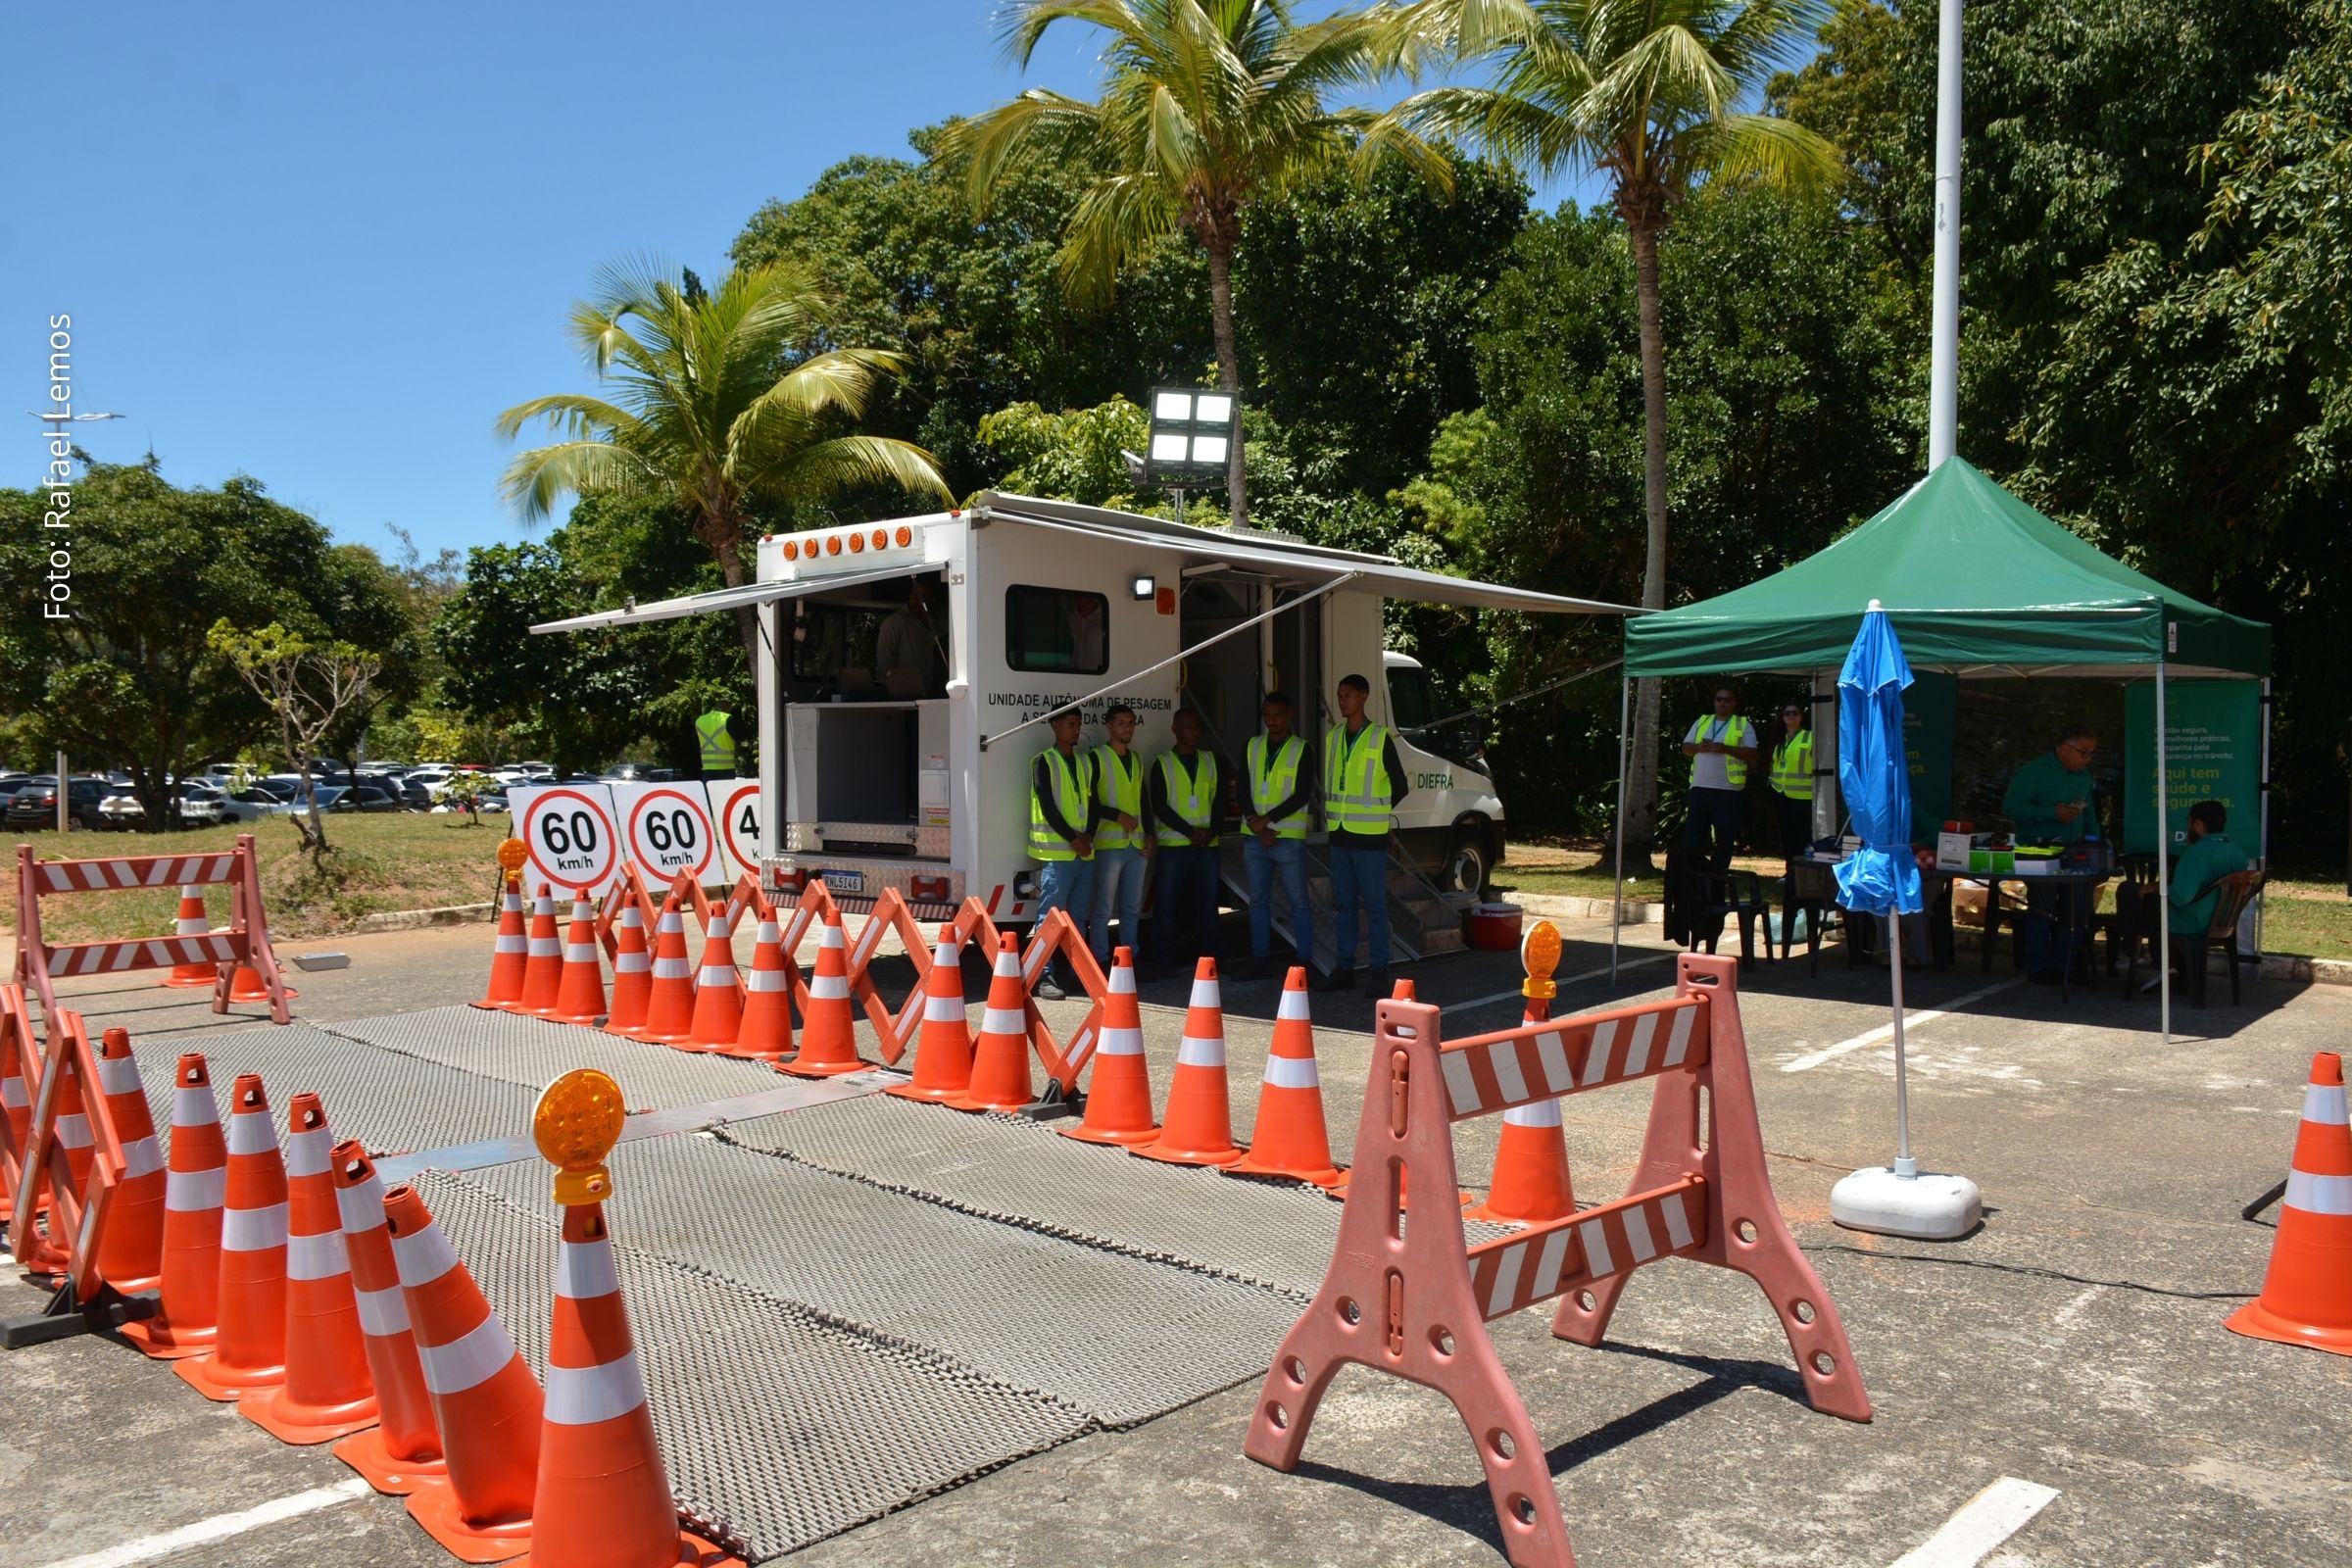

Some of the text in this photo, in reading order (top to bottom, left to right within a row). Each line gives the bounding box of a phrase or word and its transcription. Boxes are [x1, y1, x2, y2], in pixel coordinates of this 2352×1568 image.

[988, 692, 1039, 707] UNIDADE
[1106, 696, 1121, 710] DE
[1123, 697, 1172, 711] PESAGEM
[1020, 711, 1030, 724] A
[1084, 713, 1099, 725] DA
[2154, 752, 2192, 761] sgurança
[1417, 772, 1454, 789] DIEFRA
[2190, 767, 2220, 779] tem
[2151, 781, 2211, 795] súde e
[646, 809, 696, 851] 60
[739, 805, 760, 840] 4
[542, 810, 597, 855] 60
[557, 855, 594, 870] km/h
[661, 852, 694, 866] km/h
